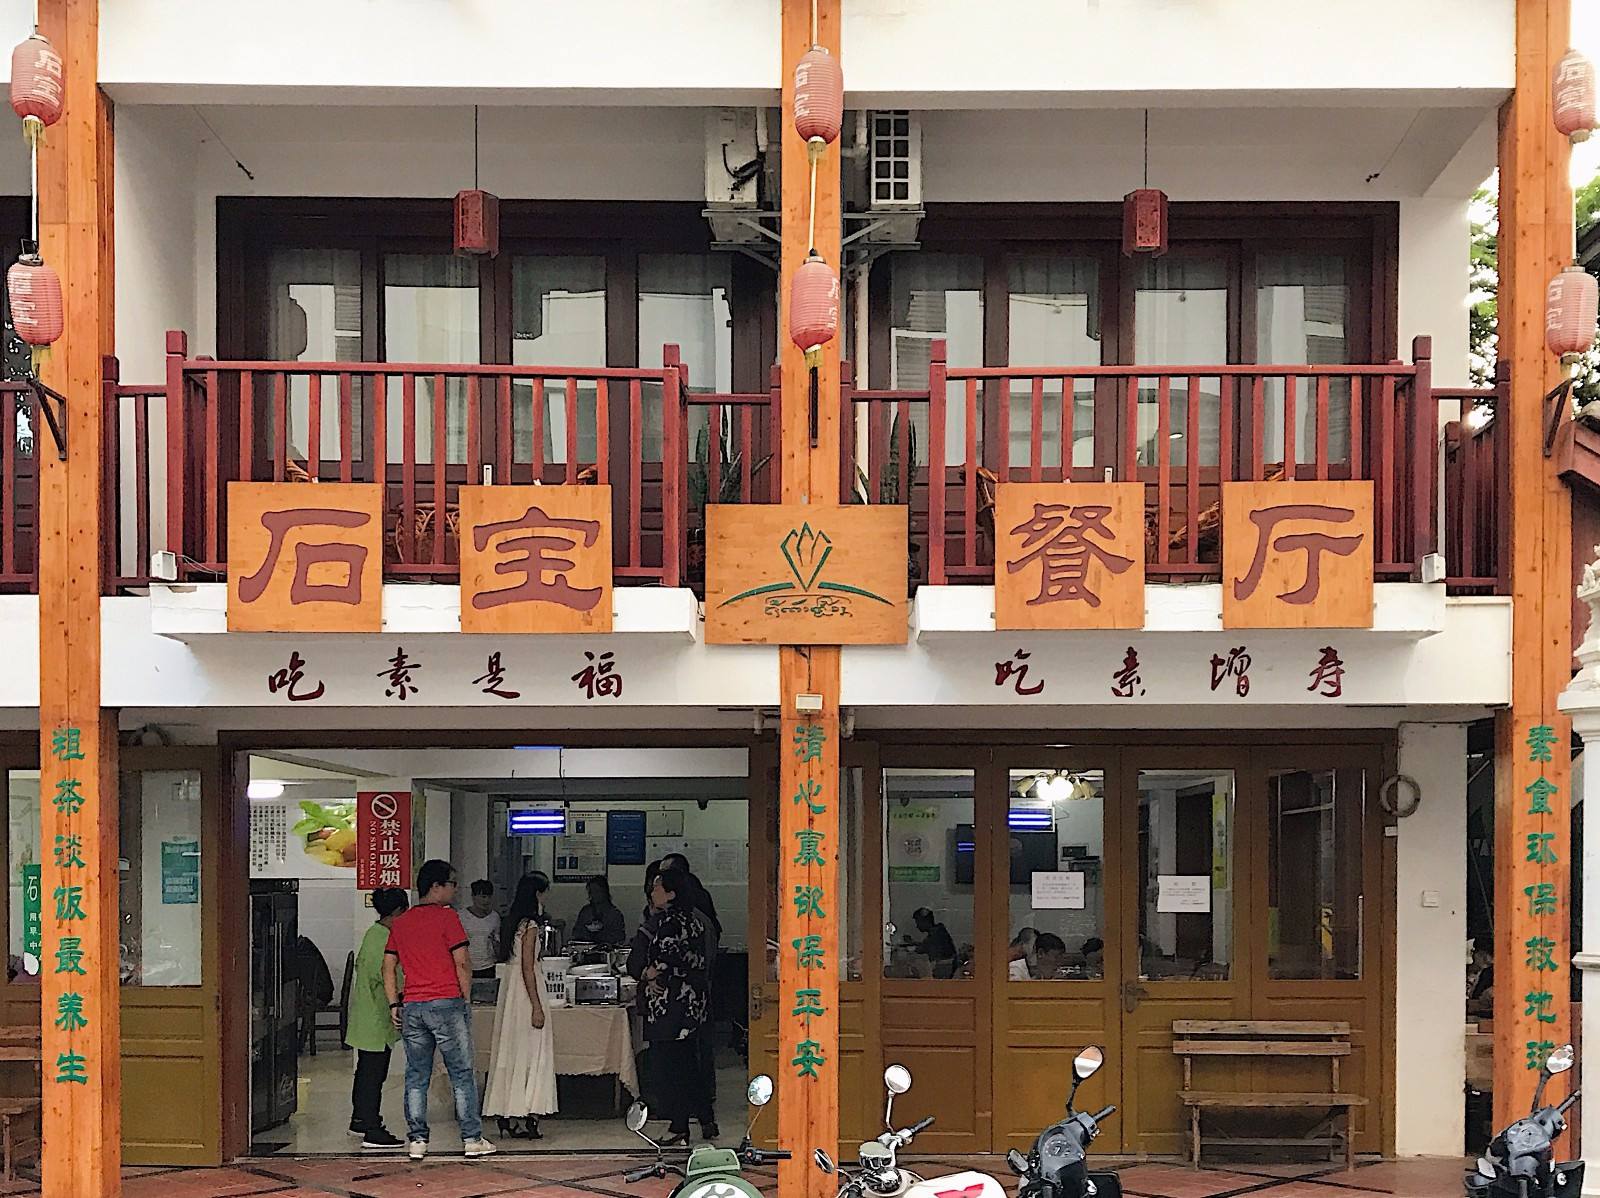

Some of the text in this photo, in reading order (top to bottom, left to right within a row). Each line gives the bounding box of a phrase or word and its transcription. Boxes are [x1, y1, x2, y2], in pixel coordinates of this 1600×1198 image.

[268, 646, 623, 701] 吃素是福
[994, 644, 1347, 698] 吃素增寿
[370, 820, 377, 835] NO
[379, 819, 400, 886] 禁止吸烟
[792, 725, 828, 1078] 清心寡欲保平安
